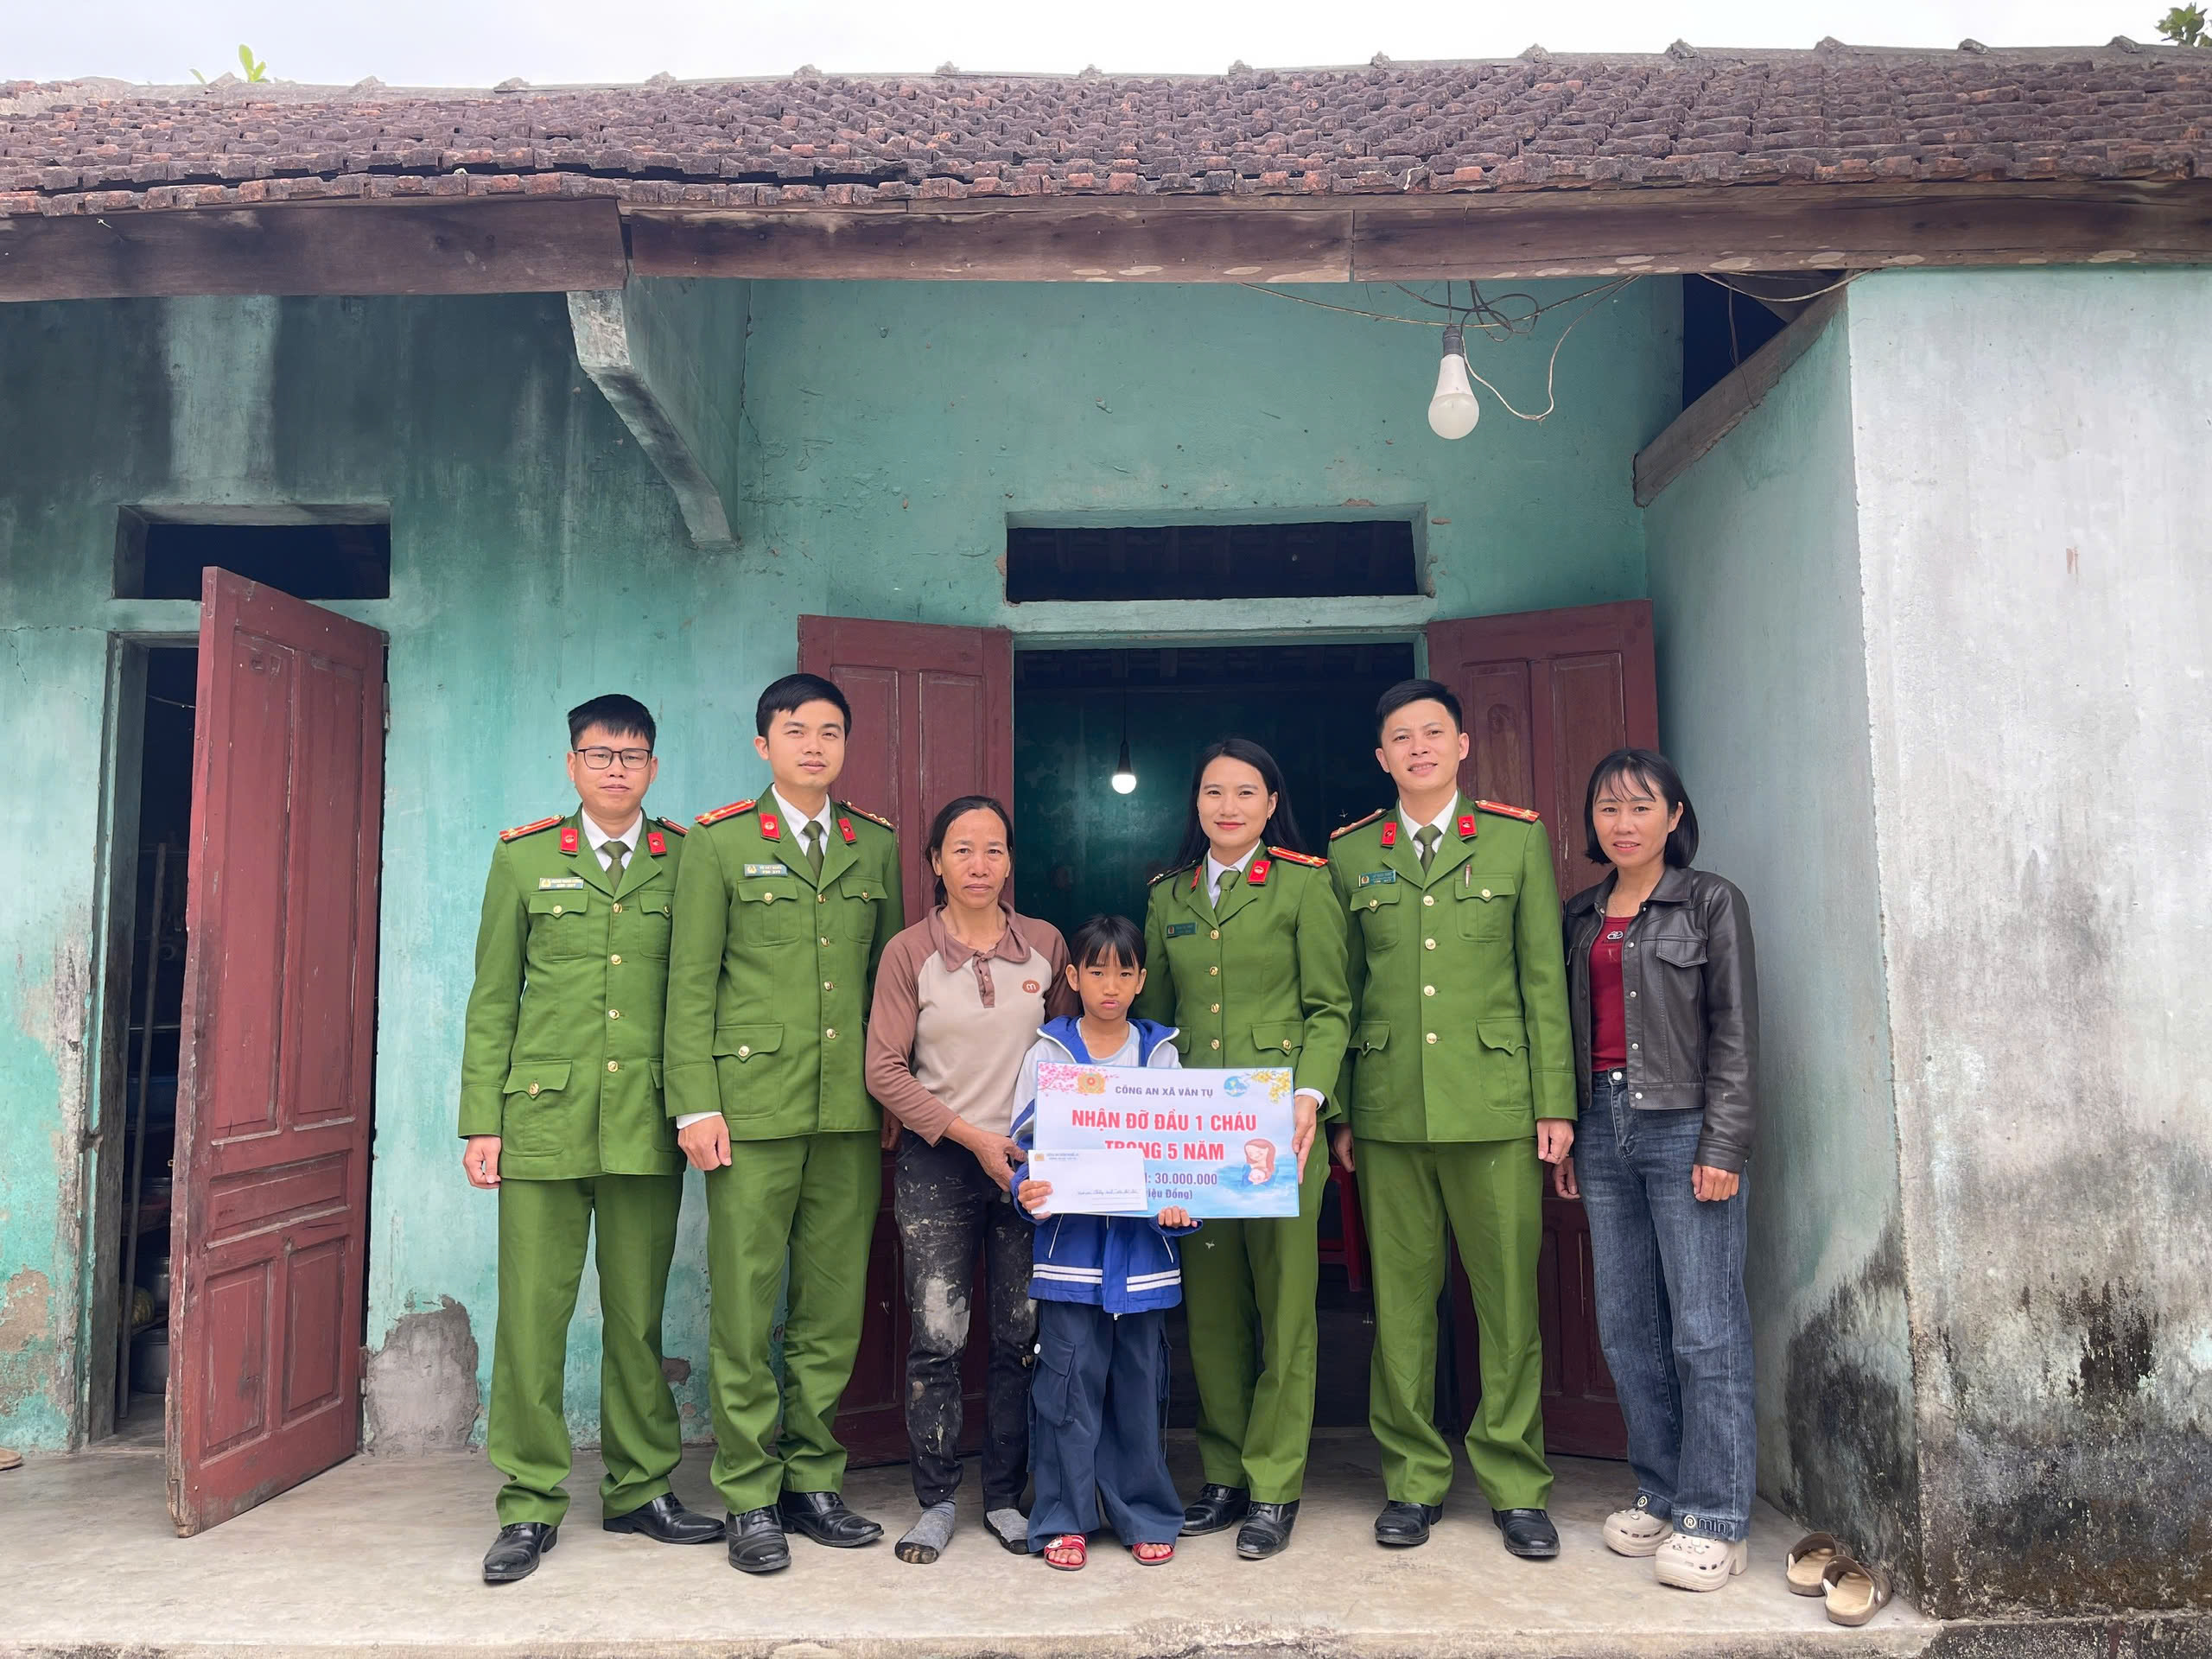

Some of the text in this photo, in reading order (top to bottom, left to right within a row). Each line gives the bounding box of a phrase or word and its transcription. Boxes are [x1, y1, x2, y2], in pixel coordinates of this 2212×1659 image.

[1116, 1084, 1142, 1095] CÔNG
[1146, 1087, 1159, 1096] AN
[1162, 1086, 1176, 1096] XÃ
[1201, 1088, 1213, 1098] TỤ
[1071, 1108, 1257, 1131] NHẬN ĐỠ ĐẦU 1 CHÁU
[1167, 1143, 1178, 1160] 5
[1183, 1140, 1224, 1160] NĂM
[1154, 1173, 1217, 1185] 30.000.000
